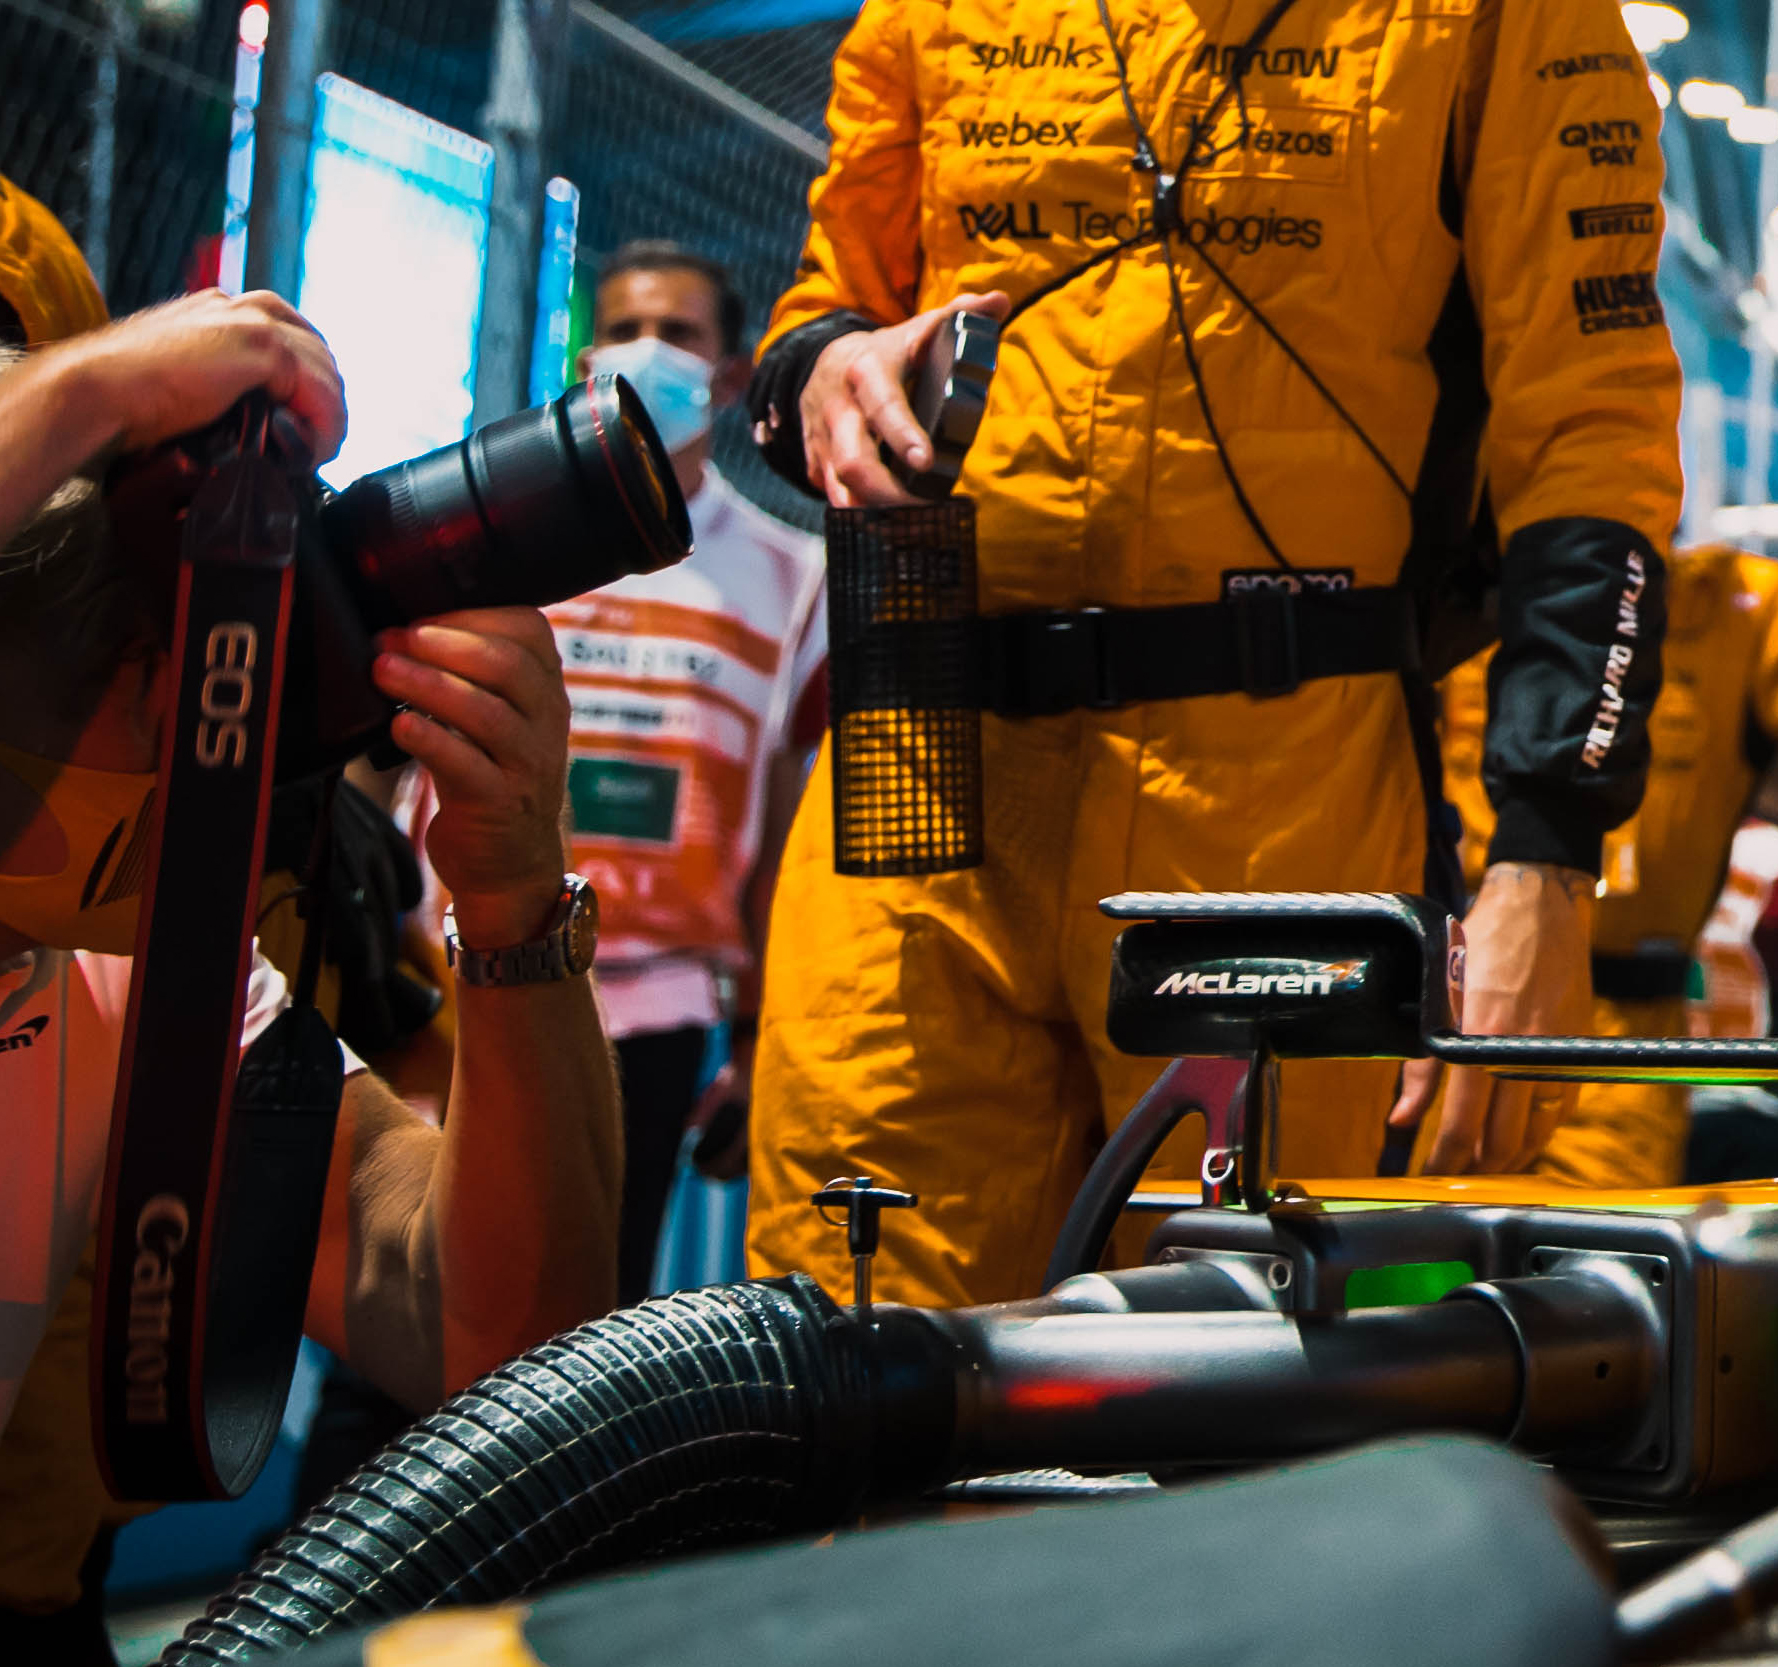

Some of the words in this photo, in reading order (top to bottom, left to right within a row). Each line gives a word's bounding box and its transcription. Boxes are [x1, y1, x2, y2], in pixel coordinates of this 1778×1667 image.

[957, 111, 1082, 150] webex
[1238, 122, 1334, 158] Tezos
[1590, 145, 1637, 167] PAY
[956, 201, 1051, 242] DELL
[1581, 642, 1634, 769] RICHARD
[1615, 548, 1646, 637] MILLE
[195, 621, 258, 768] EOS
[1154, 971, 1334, 996] McLaren
[125, 1194, 190, 1423] Canon
